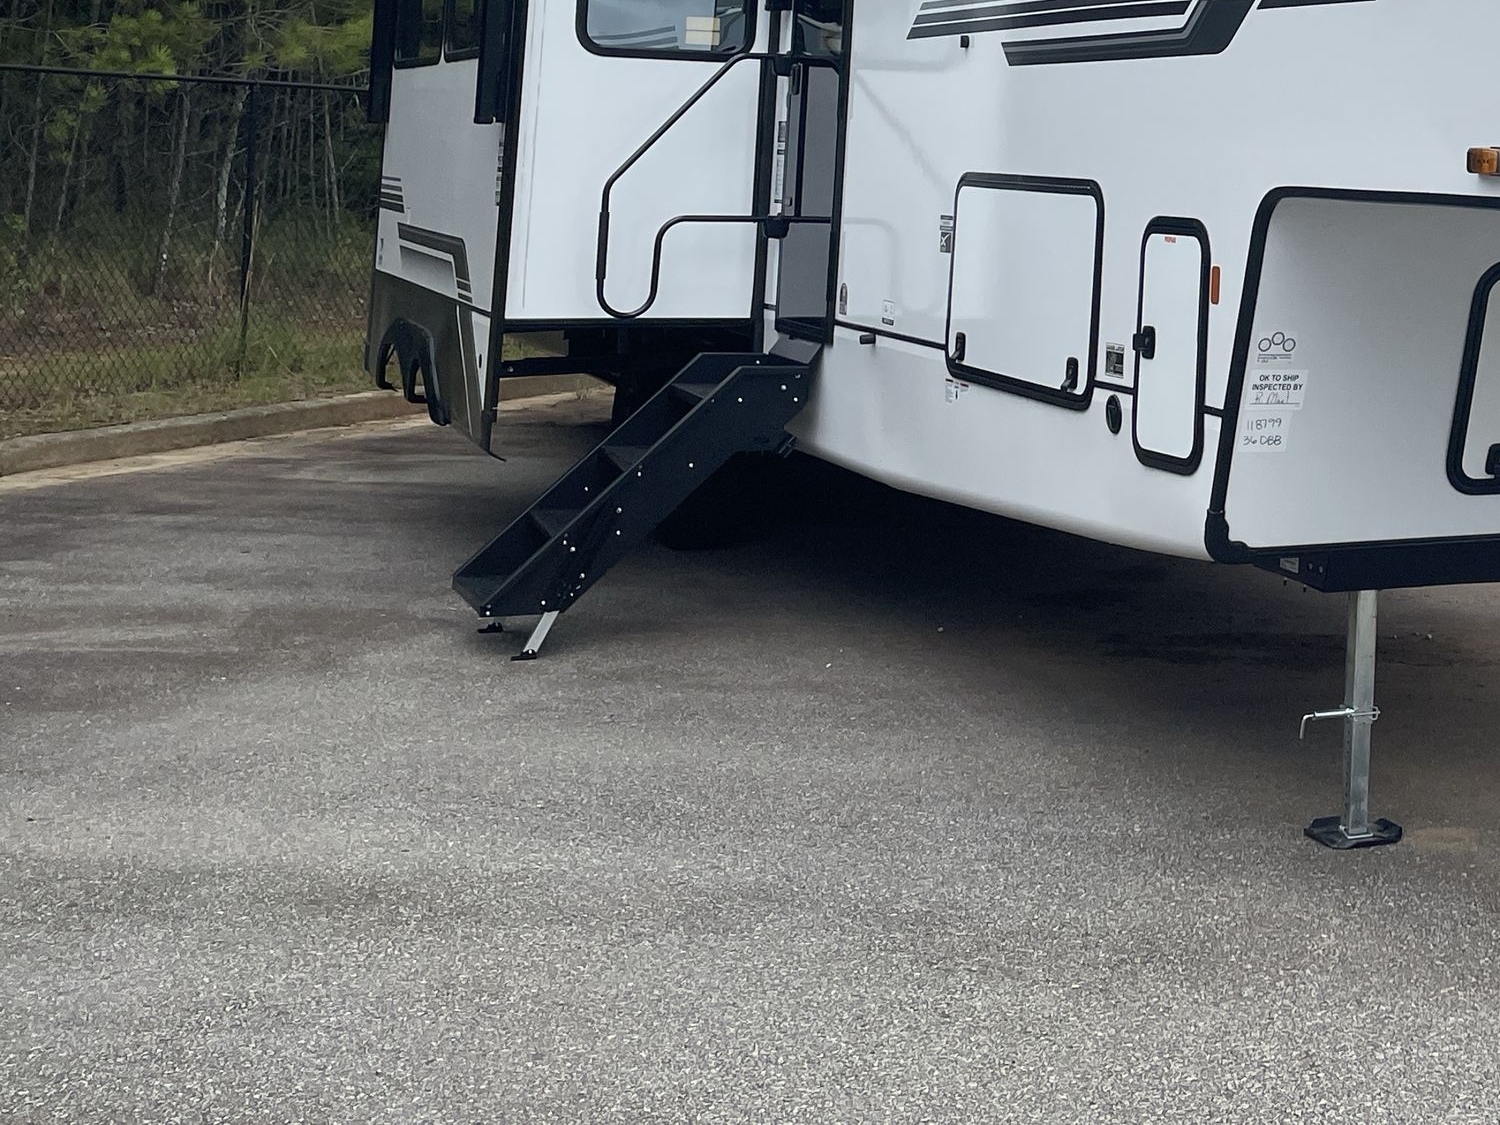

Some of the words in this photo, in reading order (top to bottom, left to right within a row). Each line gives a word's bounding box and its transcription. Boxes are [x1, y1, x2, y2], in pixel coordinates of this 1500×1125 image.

[1259, 374, 1270, 382] OK
[1272, 374, 1282, 382] TO
[1283, 374, 1300, 382] SHIP
[1252, 383, 1291, 391] INSPECTED
[1293, 383, 1303, 391] BY
